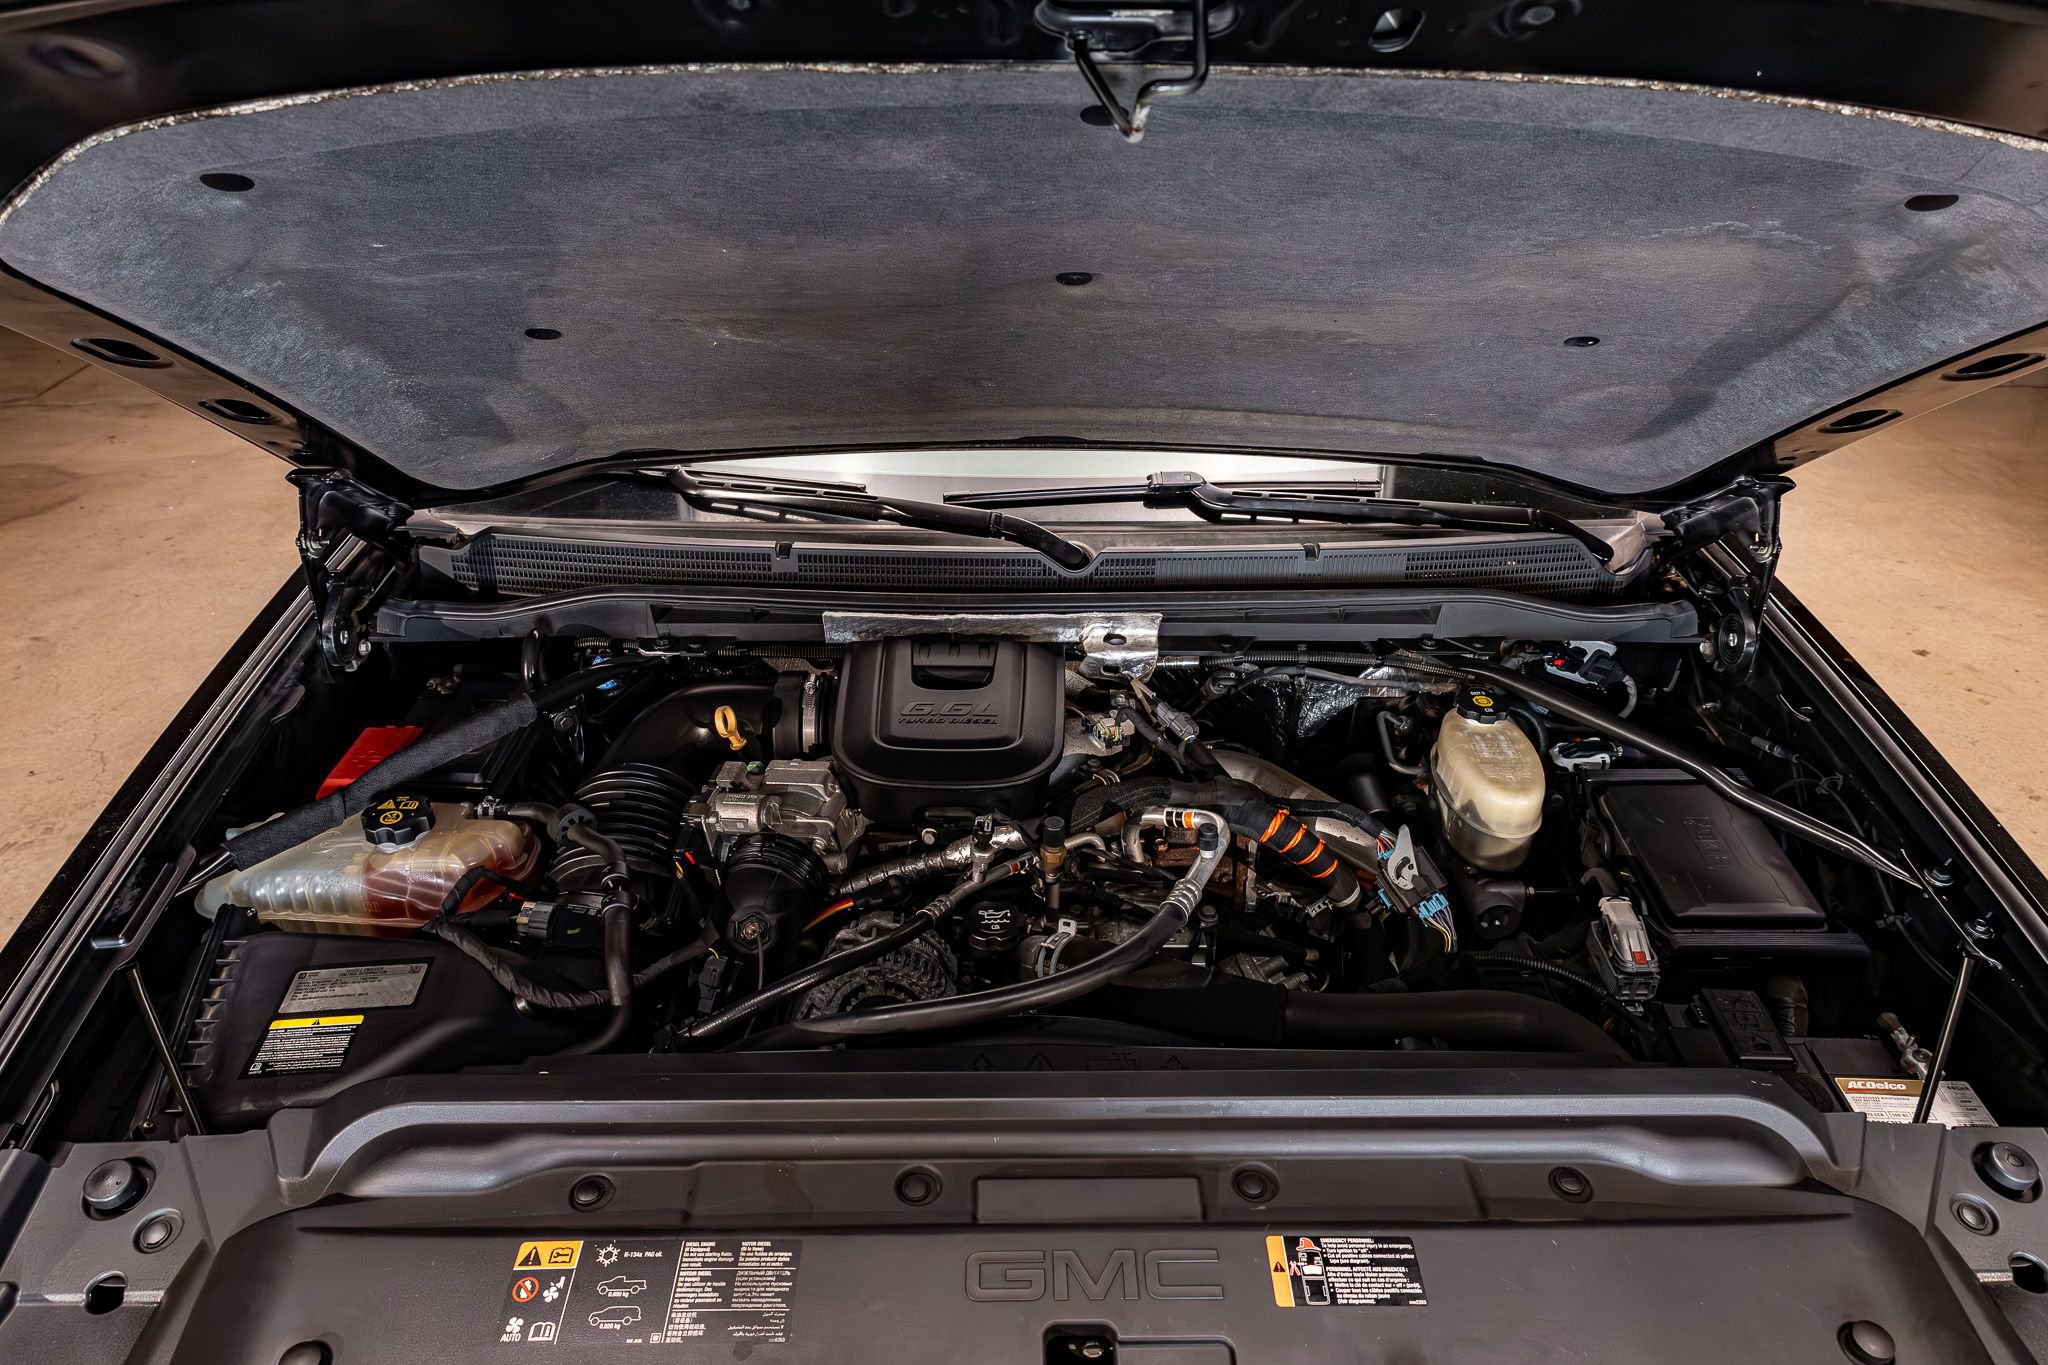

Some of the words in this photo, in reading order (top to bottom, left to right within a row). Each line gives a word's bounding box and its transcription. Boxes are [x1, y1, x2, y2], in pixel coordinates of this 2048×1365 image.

[900, 702, 999, 717] 6.6L
[1848, 1081, 1906, 1090] ACDelco
[965, 1249, 1224, 1302] GMC
[500, 1334, 521, 1342] AUTO
